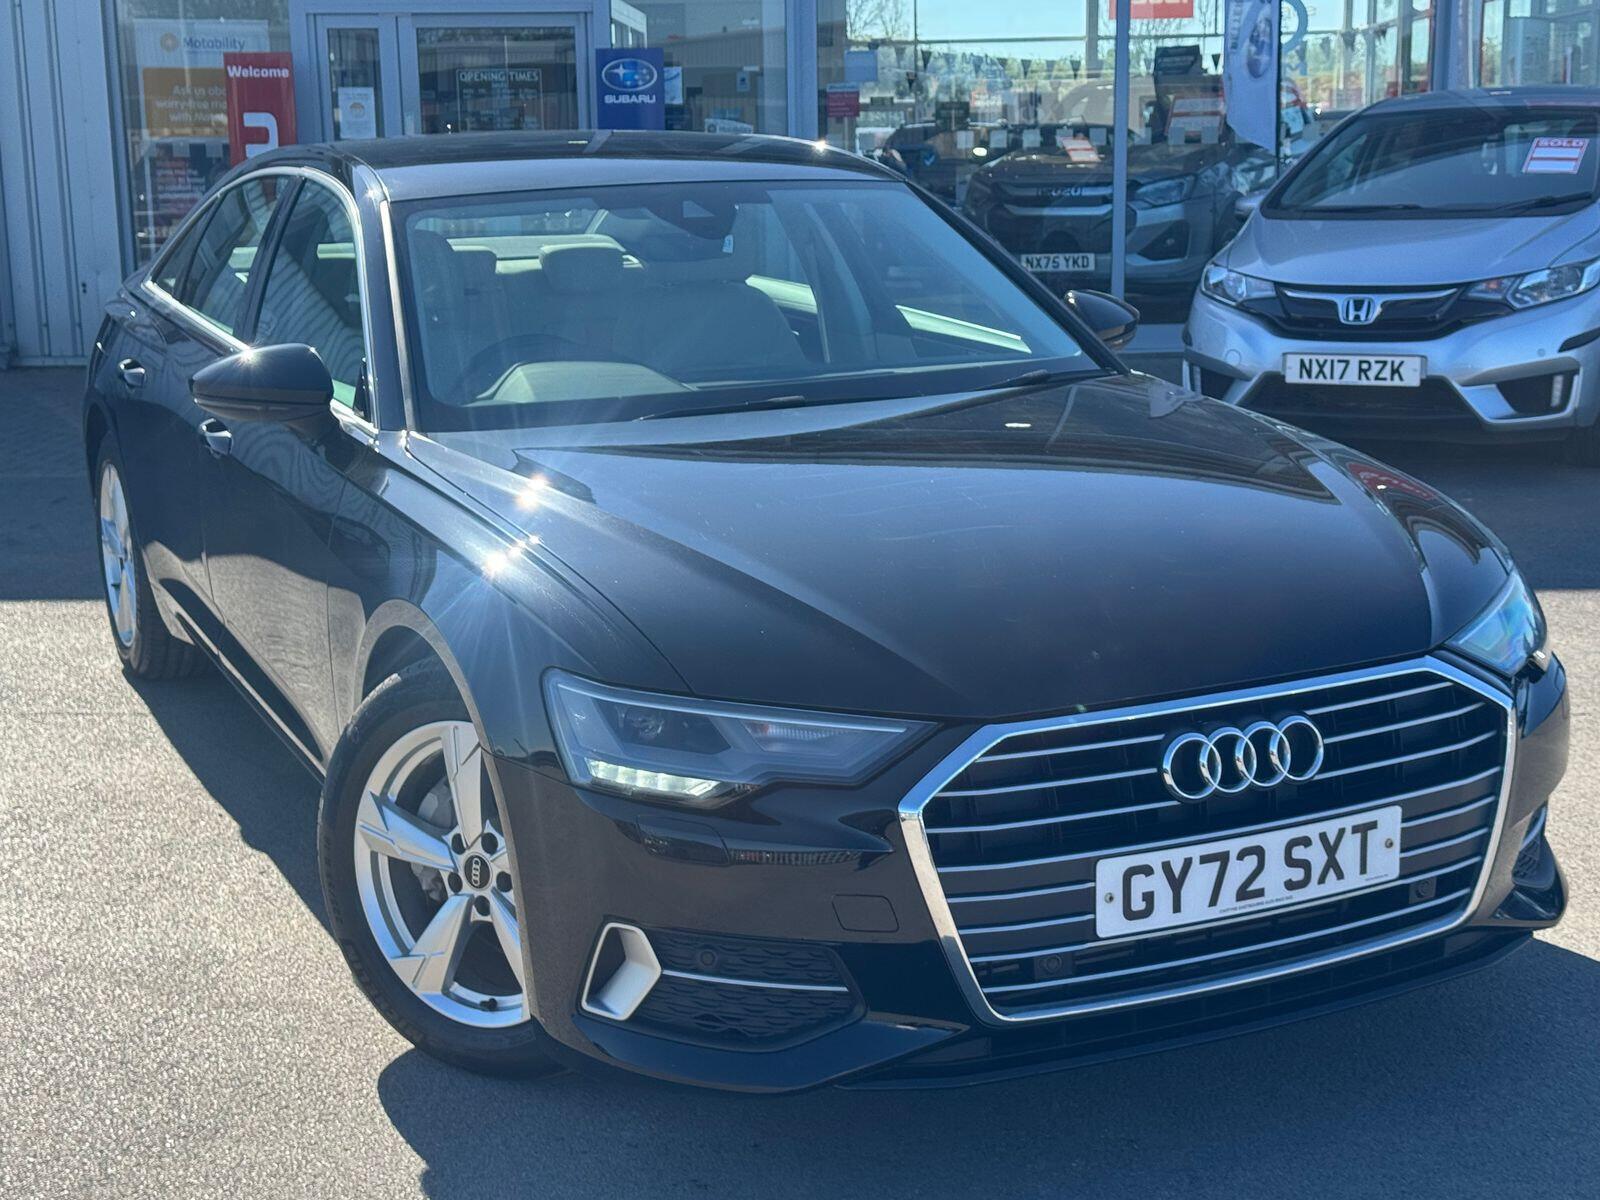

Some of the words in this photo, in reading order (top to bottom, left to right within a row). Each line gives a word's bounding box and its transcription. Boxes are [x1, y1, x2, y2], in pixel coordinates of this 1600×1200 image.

[183, 37, 245, 50] Motability
[227, 65, 289, 78] Welcome
[460, 71, 506, 81] OPENING
[509, 71, 538, 81] TIMES
[604, 94, 656, 104] SUBARU
[1538, 138, 1584, 147] SOLD
[1025, 255, 1060, 269] NX75
[1064, 254, 1090, 268] YKD
[1298, 358, 1350, 380] NX17
[1358, 360, 1405, 381] RZK
[1122, 844, 1266, 921] GY72
[1283, 820, 1378, 892] SXT
